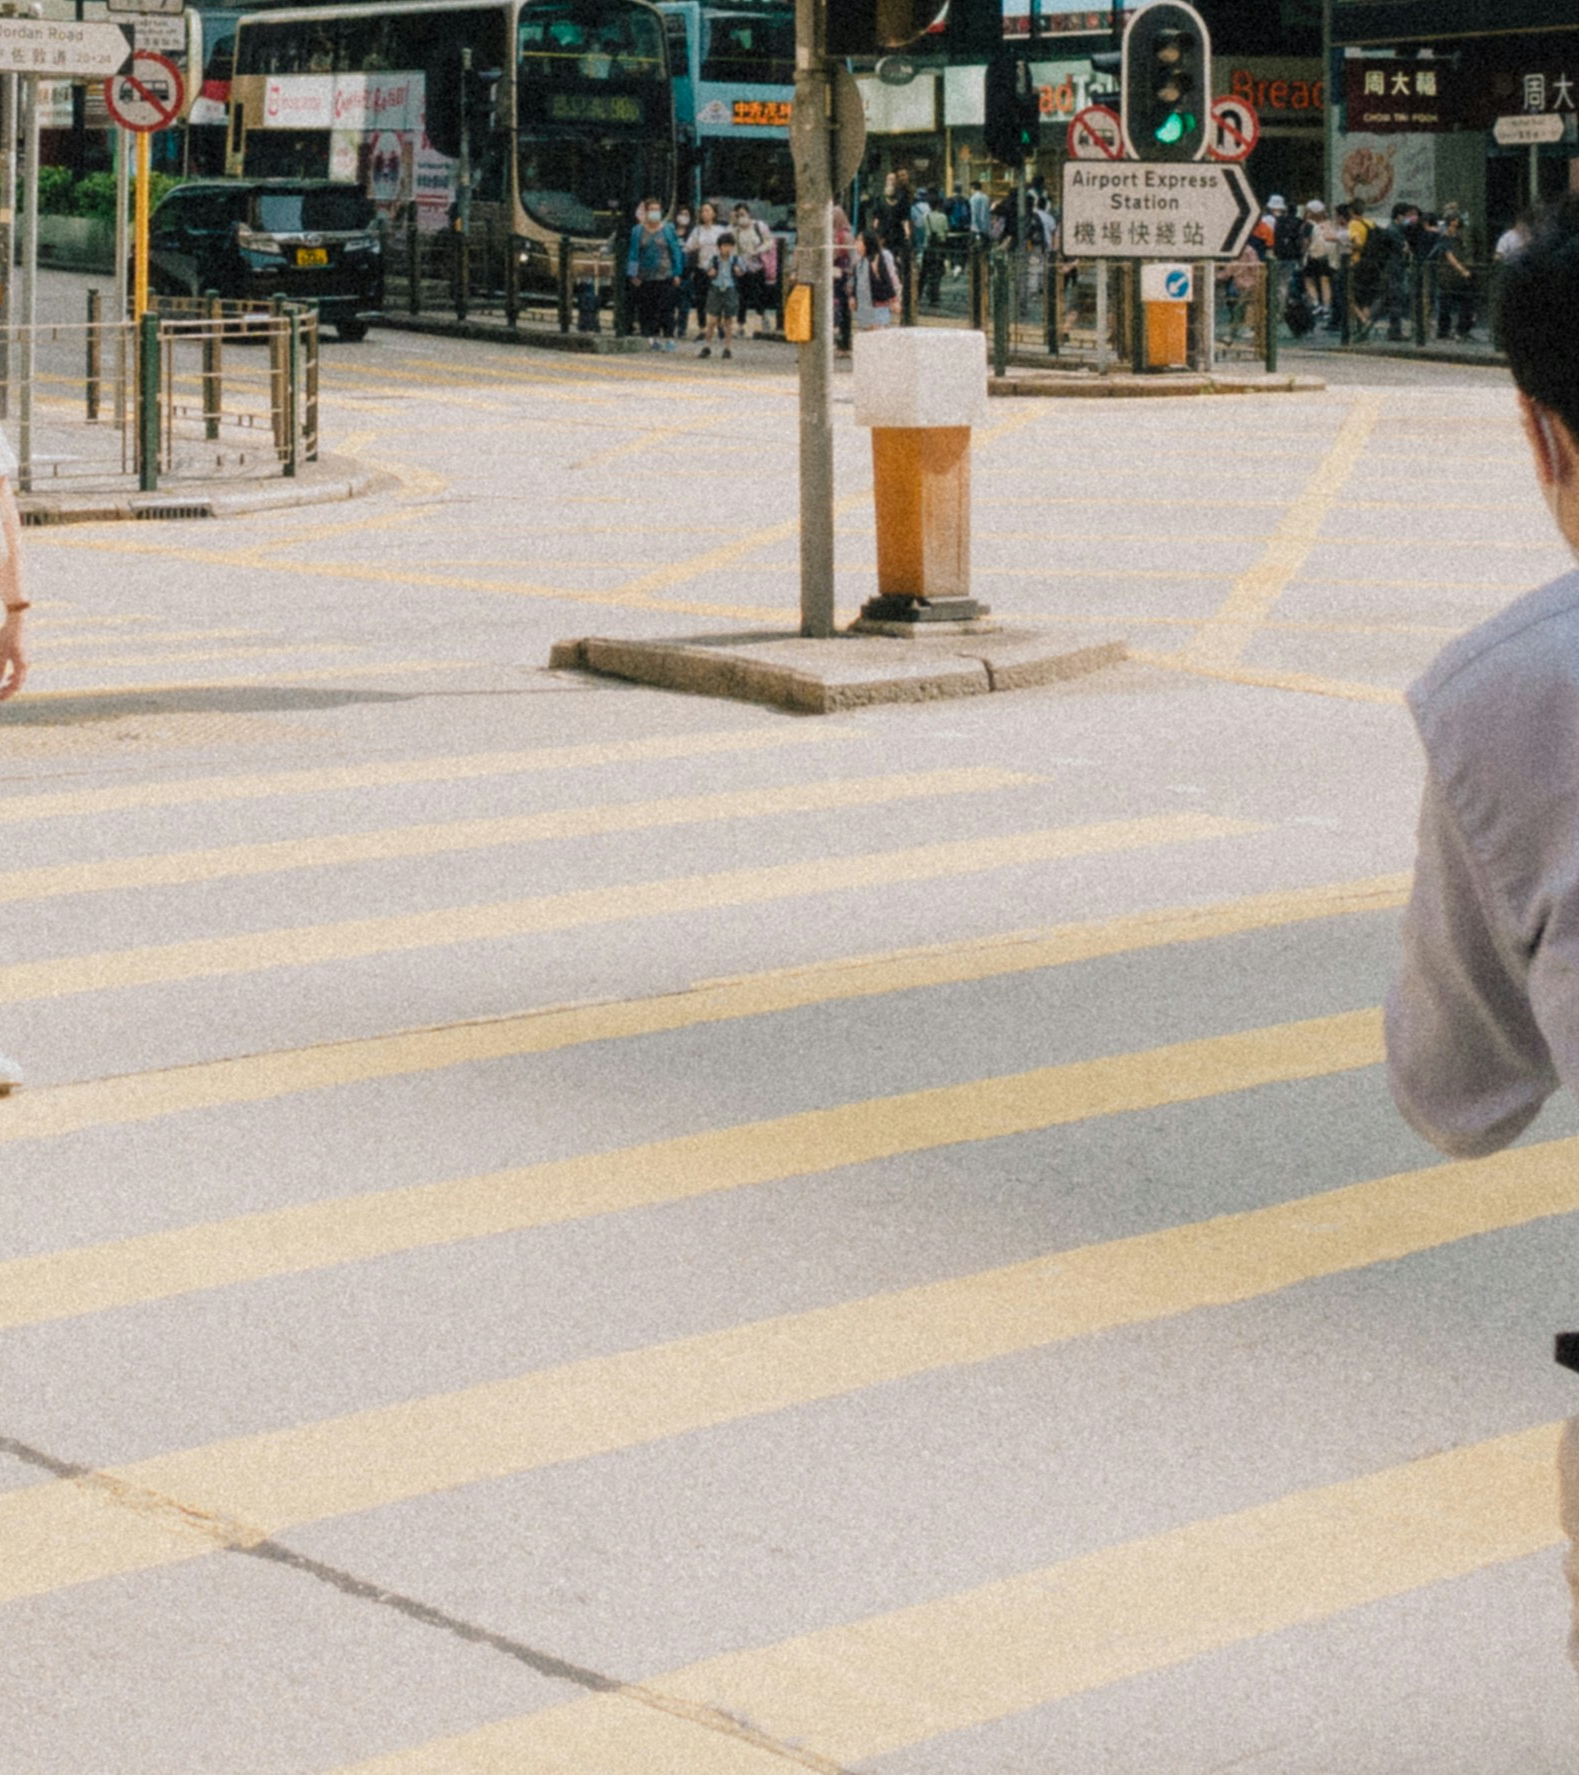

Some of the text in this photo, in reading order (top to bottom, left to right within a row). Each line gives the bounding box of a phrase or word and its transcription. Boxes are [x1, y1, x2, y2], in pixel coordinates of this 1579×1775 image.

[48, 28, 84, 42] Road
[12, 47, 67, 66] 佐敦道
[1364, 70, 1437, 97] 周大福
[1072, 169, 1219, 190] Airport Express
[1110, 193, 1180, 211] Station
[1072, 223, 1207, 247] 機場快綫站
